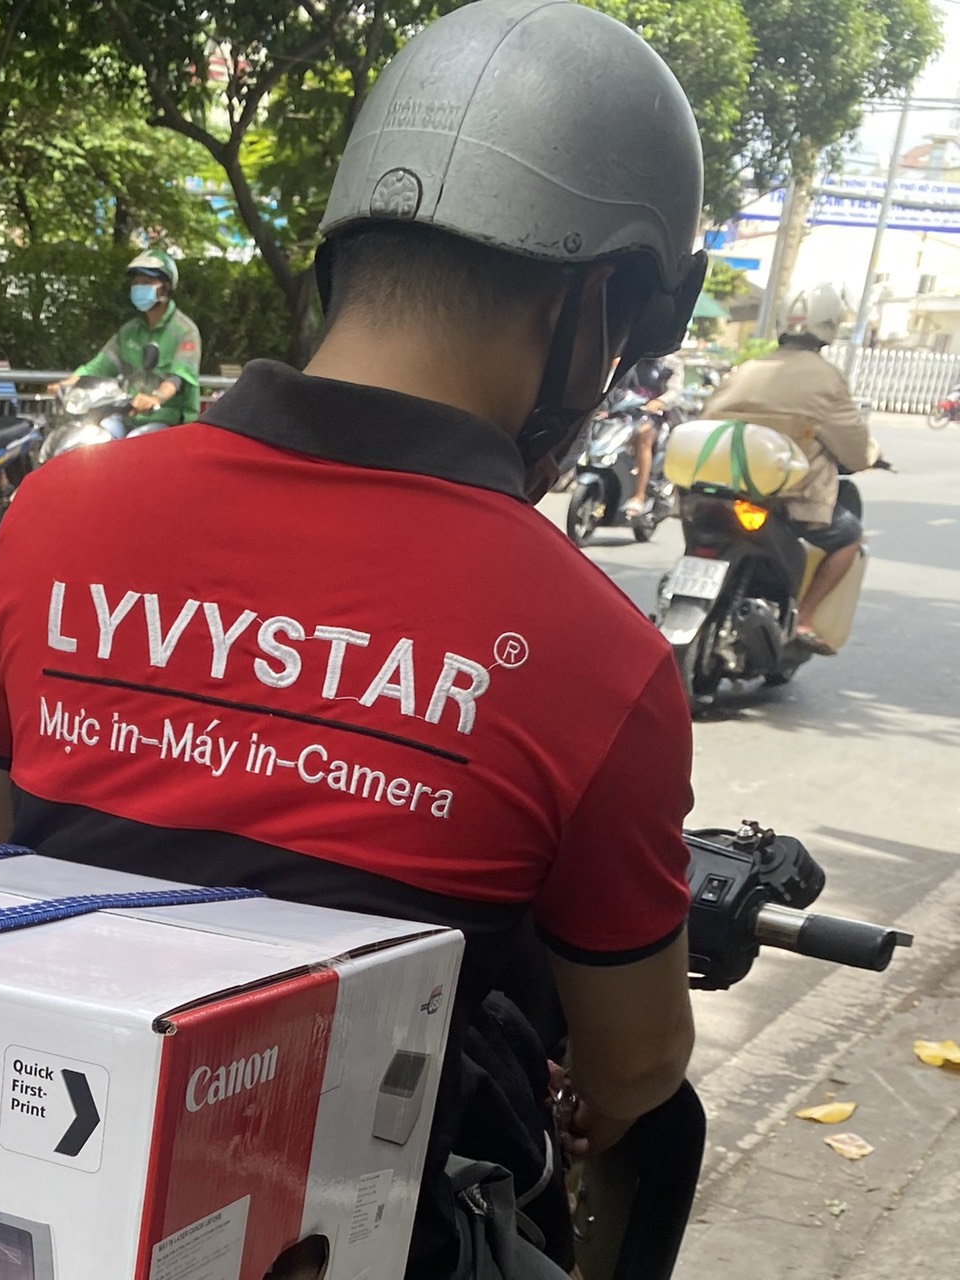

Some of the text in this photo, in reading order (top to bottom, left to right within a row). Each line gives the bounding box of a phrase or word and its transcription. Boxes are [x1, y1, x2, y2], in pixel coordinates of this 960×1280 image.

[40, 696, 100, 754] Mực
[13, 1059, 54, 1081] Quick
[185, 1044, 279, 1113] Canon
[11, 1079, 48, 1099] First-
[11, 1098, 46, 1119] Print
